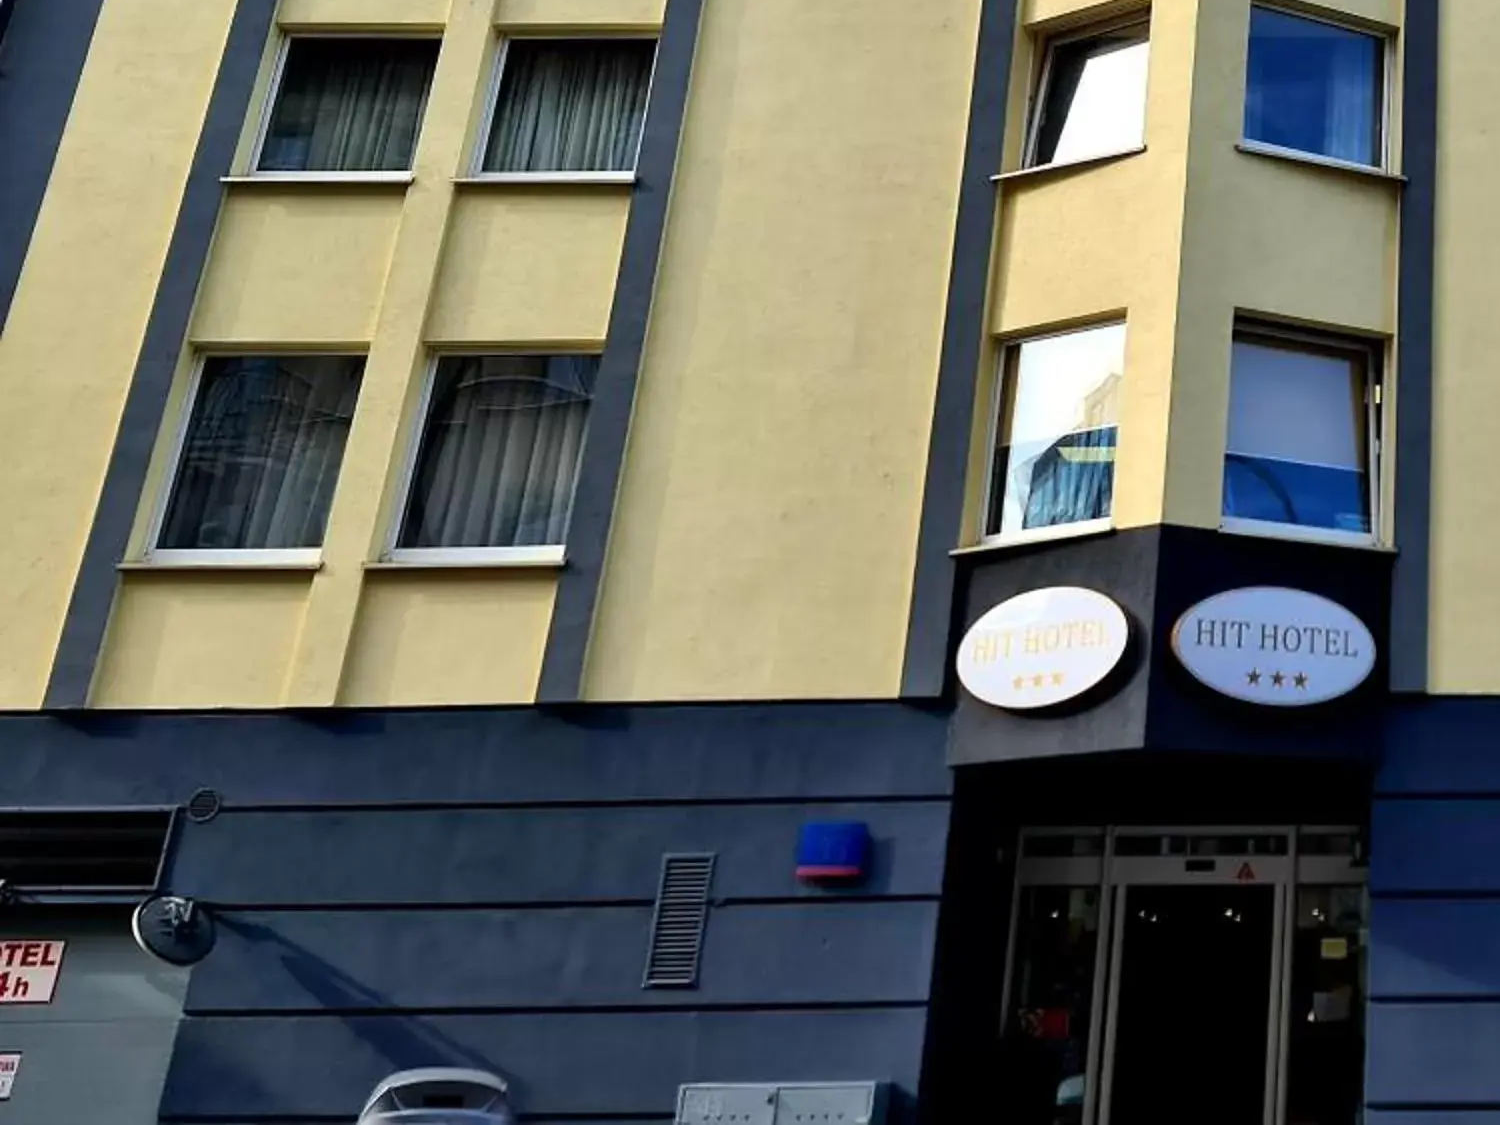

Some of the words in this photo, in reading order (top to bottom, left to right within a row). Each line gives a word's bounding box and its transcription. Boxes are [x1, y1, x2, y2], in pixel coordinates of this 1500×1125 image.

[972, 627, 1014, 663] HIT
[1022, 618, 1110, 654] HOTEL
[1195, 618, 1251, 649] HIT
[1258, 622, 1359, 658] HOTEL
[0, 943, 56, 967] TEL
